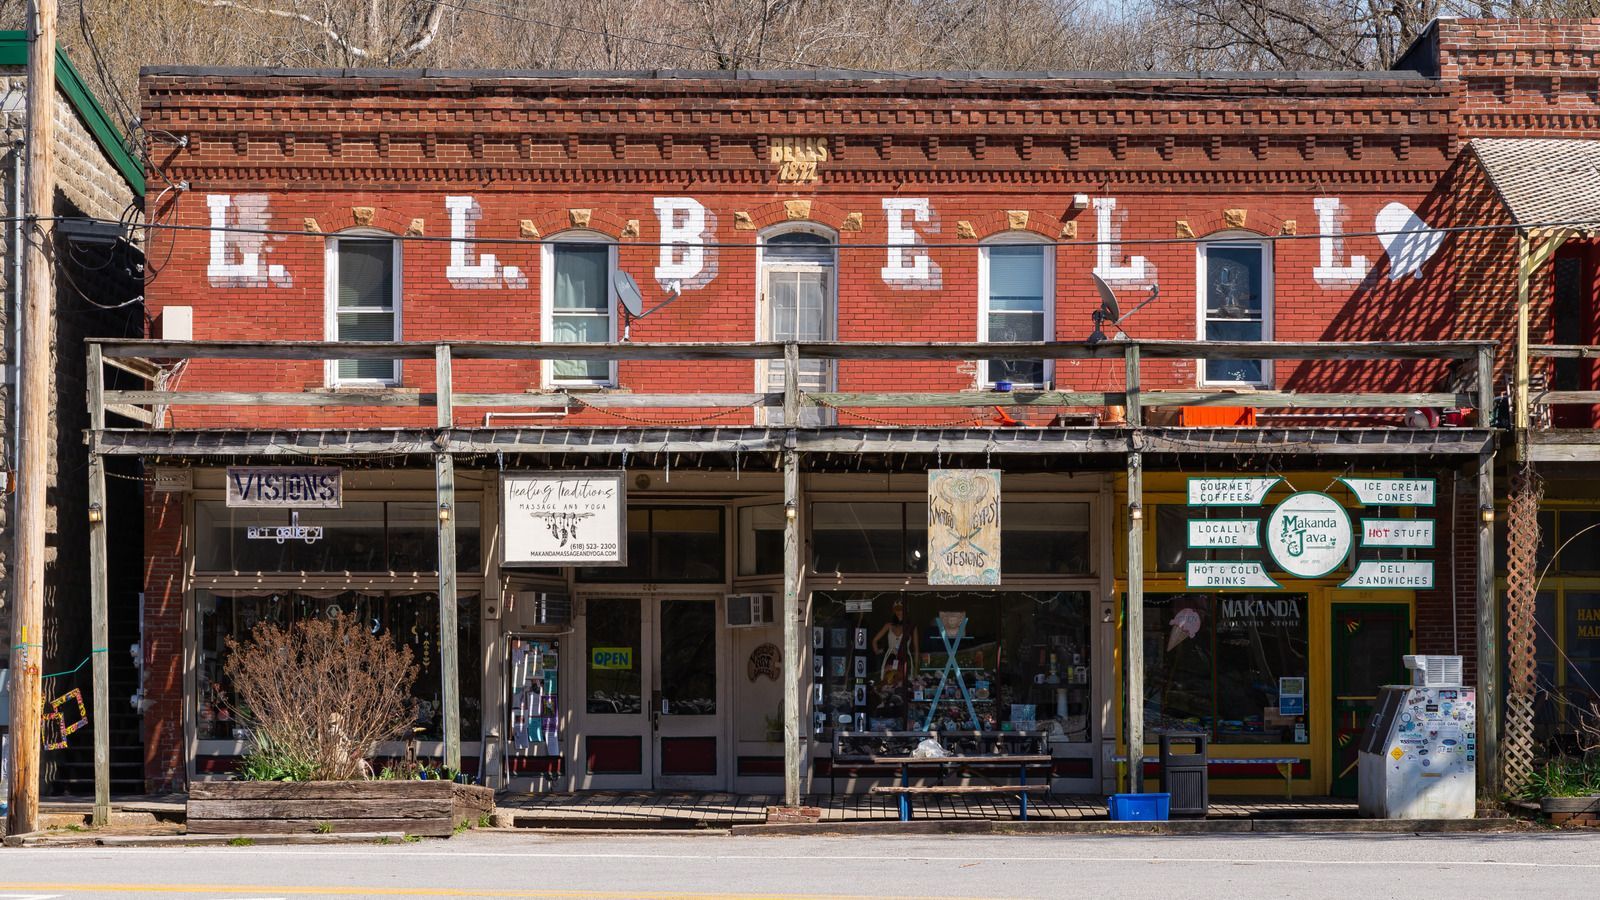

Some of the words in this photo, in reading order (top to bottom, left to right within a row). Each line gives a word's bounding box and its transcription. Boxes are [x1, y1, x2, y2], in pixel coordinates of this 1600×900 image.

[777, 161, 818, 181] 1892
[234, 472, 335, 501] VISIONS
[510, 479, 553, 503] Healing
[556, 479, 616, 501] Traditions
[1200, 482, 1251, 491] GOURMET
[1364, 482, 1382, 491] ICE
[1391, 482, 1427, 491] CREAM
[1200, 493, 1251, 502] COFFEES
[1377, 493, 1413, 502] CONES
[248, 527, 270, 538] art
[276, 511, 320, 544] gallery
[1198, 524, 1248, 533] LOCALLY
[1283, 515, 1337, 534] Makanda
[1368, 528, 1390, 538] HOT
[1394, 529, 1430, 538] STUFF
[1209, 535, 1238, 544] MADE
[1287, 529, 1327, 557] Java
[946, 551, 985, 568] DESIGNS
[1194, 566, 1214, 574] HOT
[1219, 566, 1226, 574] &
[1231, 566, 1259, 574] COLD
[1380, 565, 1405, 573] DELI
[1207, 577, 1246, 585] DRINKS
[1358, 576, 1428, 585] SANDWICHES
[1222, 600, 1300, 618] MAKANDA
[593, 651, 629, 666] OPEN
